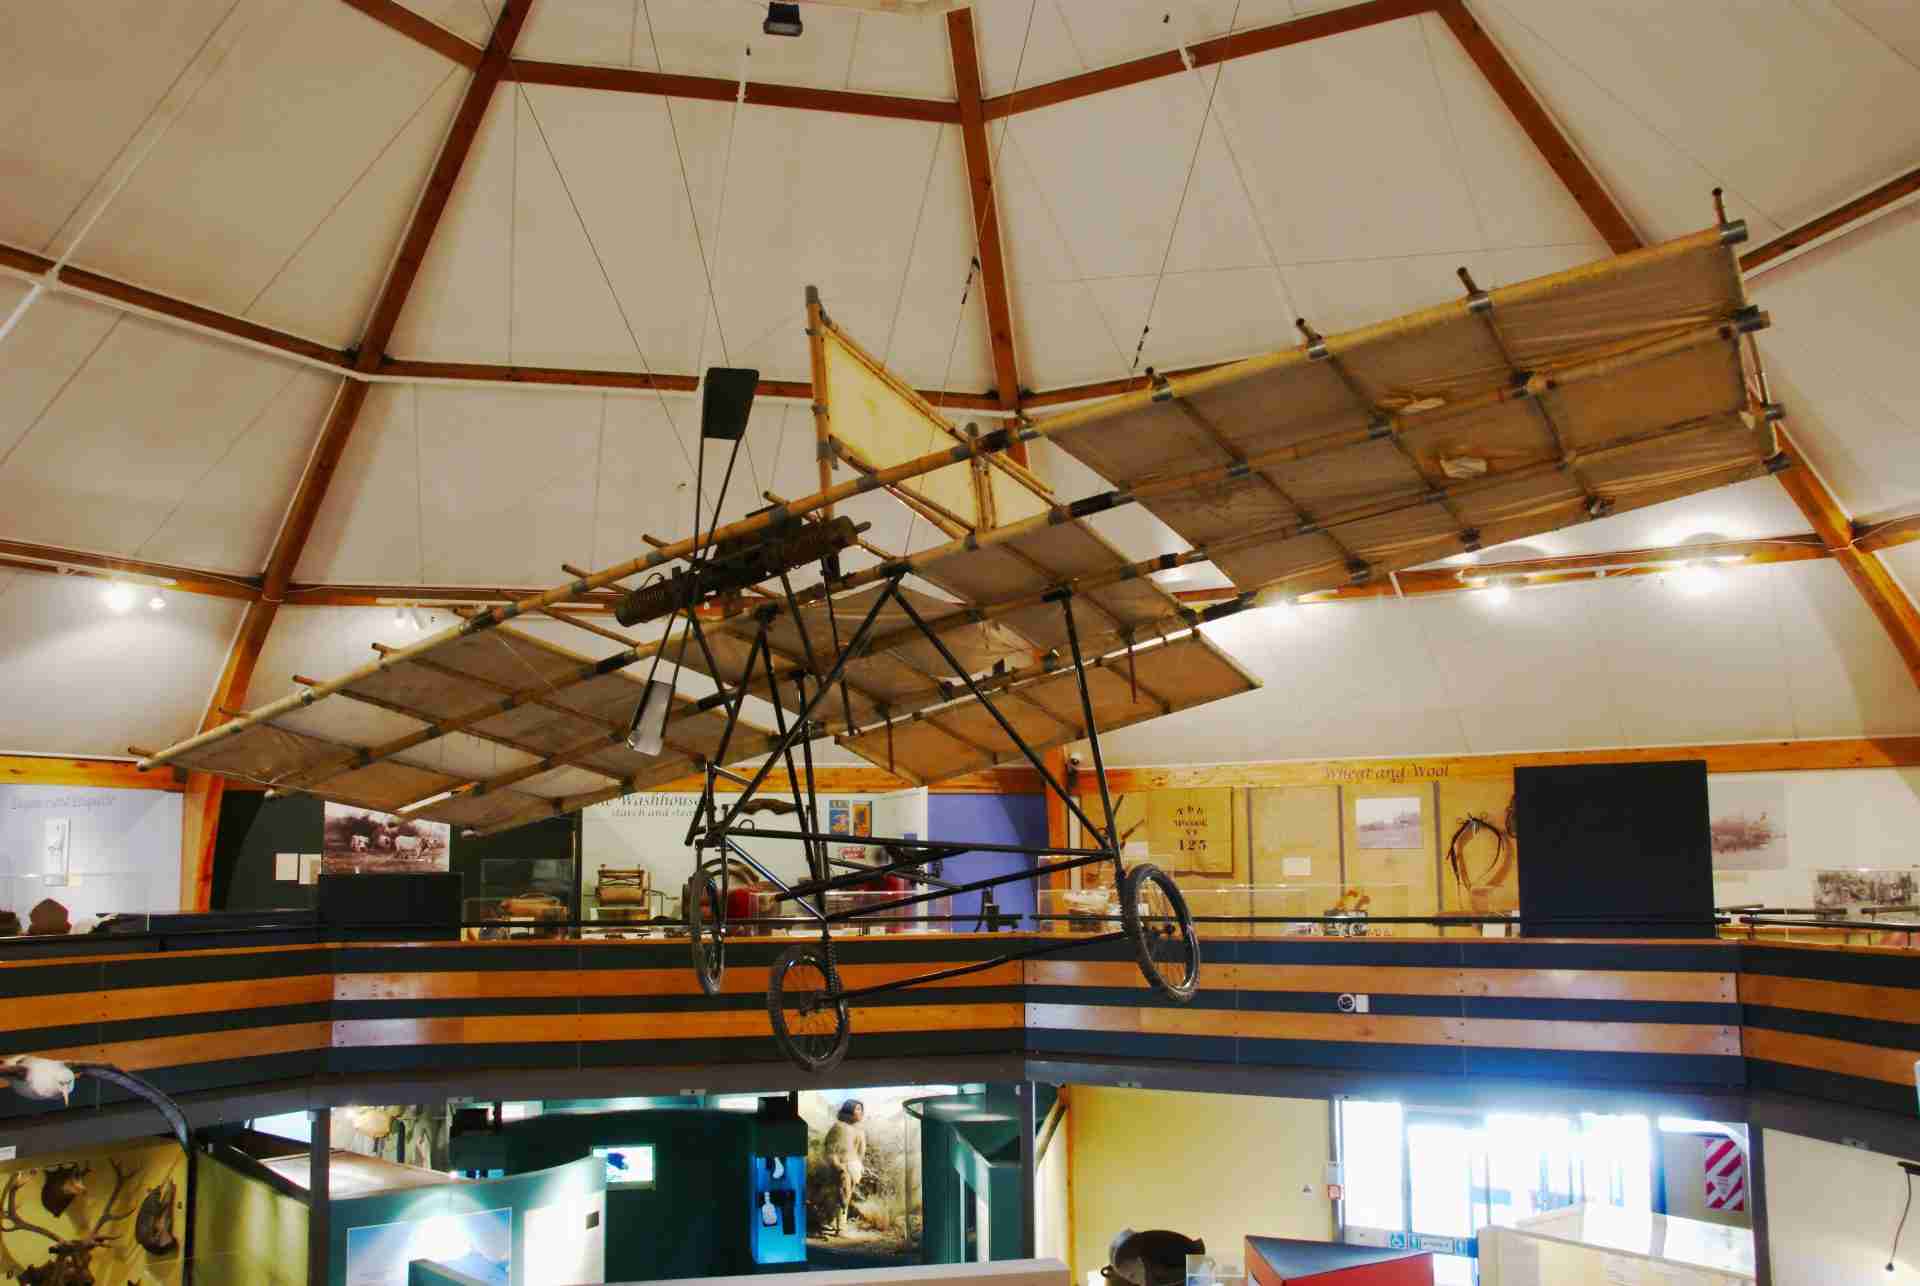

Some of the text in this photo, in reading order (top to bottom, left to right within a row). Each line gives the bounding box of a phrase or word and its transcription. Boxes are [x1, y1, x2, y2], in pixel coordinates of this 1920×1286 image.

[1375, 765, 1405, 780] and
[1412, 762, 1449, 777] Wool
[1178, 838, 1208, 851] 125
